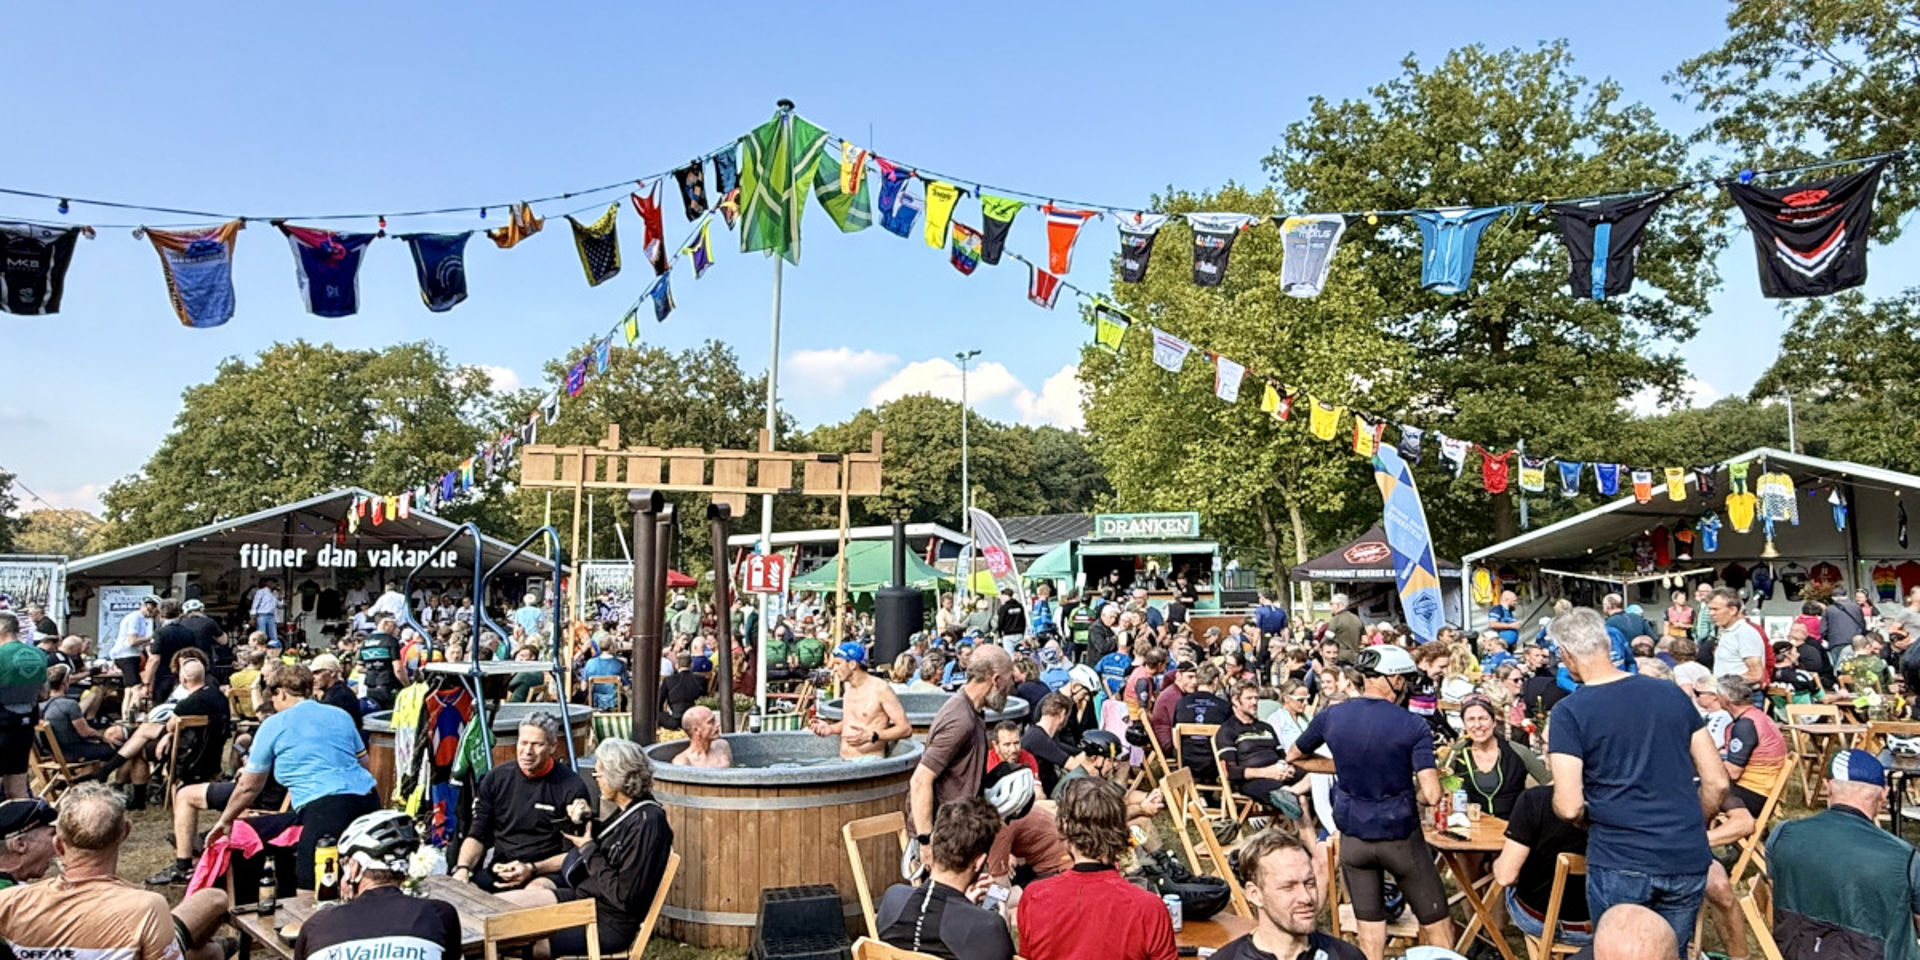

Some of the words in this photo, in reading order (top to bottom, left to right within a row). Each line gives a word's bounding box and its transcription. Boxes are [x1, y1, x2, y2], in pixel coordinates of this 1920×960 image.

[1103, 519, 1190, 534] DRANKEN
[239, 543, 307, 572] fijner
[317, 544, 357, 568] dan
[367, 544, 459, 568] vakantie
[20, 950, 49, 959] OFF
[345, 942, 427, 960] Vaillant
